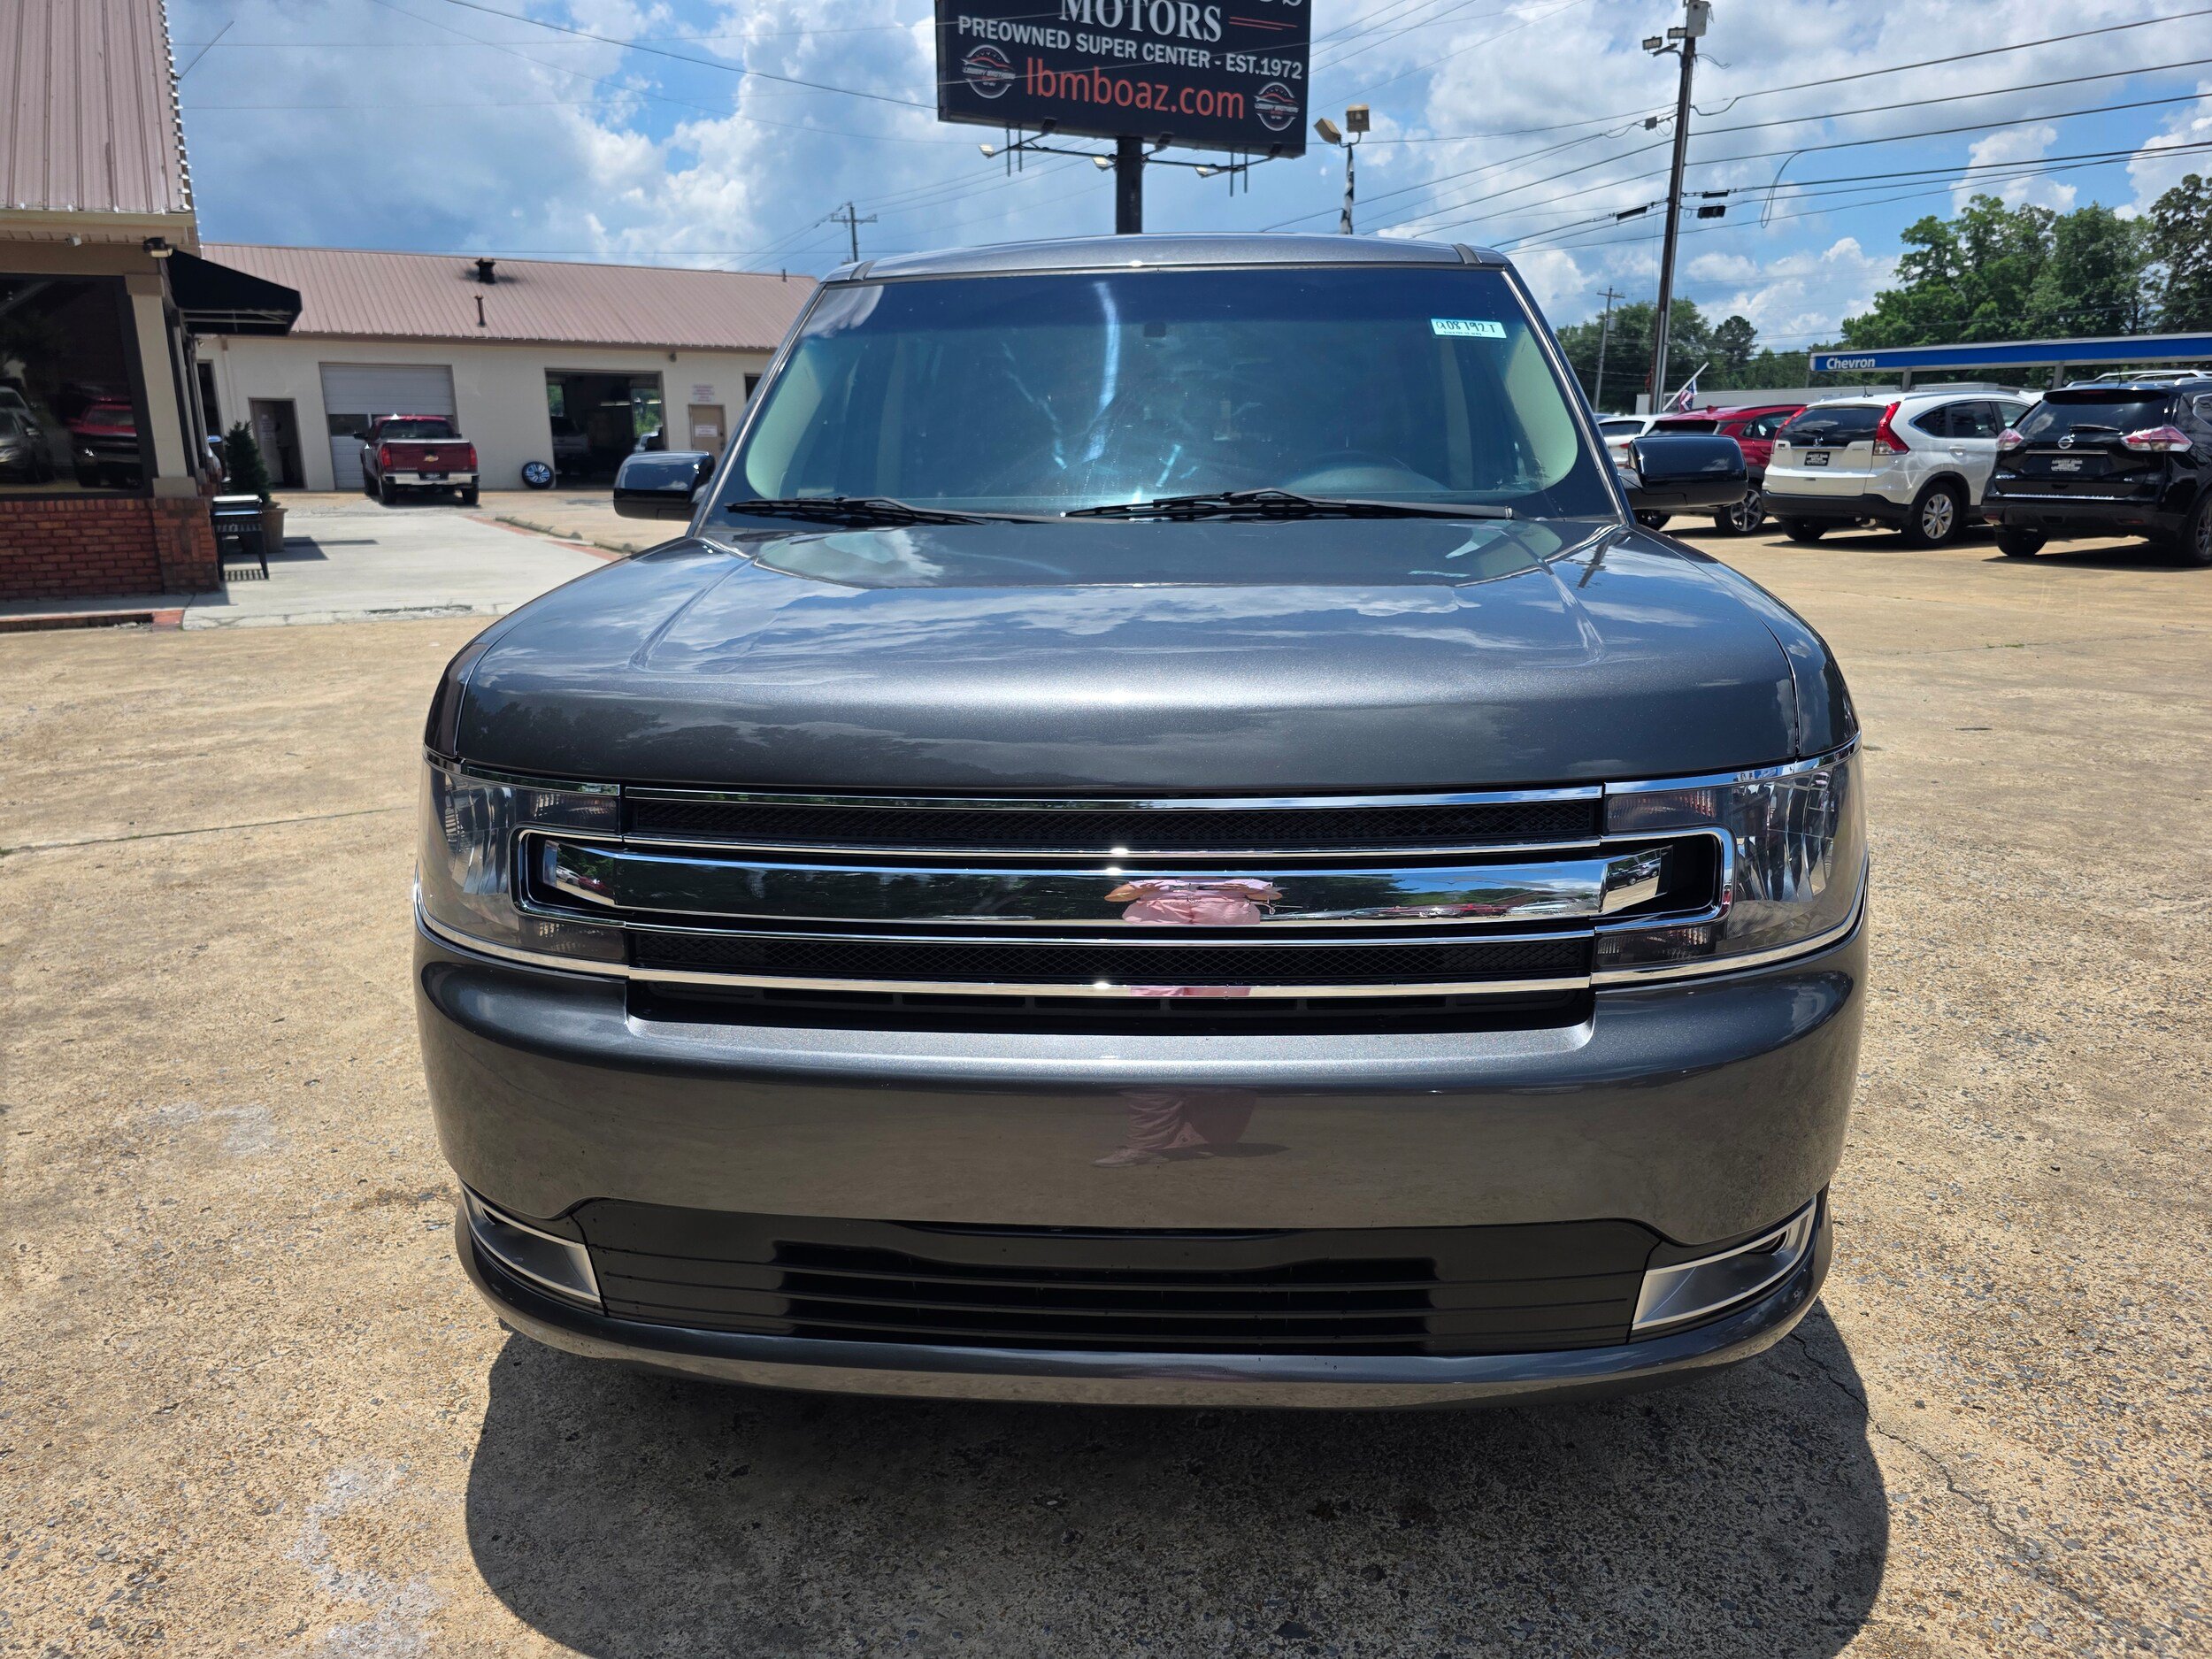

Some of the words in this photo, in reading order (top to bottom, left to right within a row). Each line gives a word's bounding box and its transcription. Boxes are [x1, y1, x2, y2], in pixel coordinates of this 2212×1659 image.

[1057, 0, 1222, 42] MOTORS
[958, 15, 1071, 50] PREOWNED
[1075, 33, 1138, 59] SUPER
[1141, 42, 1210, 69] CENTER
[1225, 53, 1302, 80] EST.1972
[1026, 57, 1245, 119] lbmboaz.com
[1826, 357, 1876, 370] Chevron
